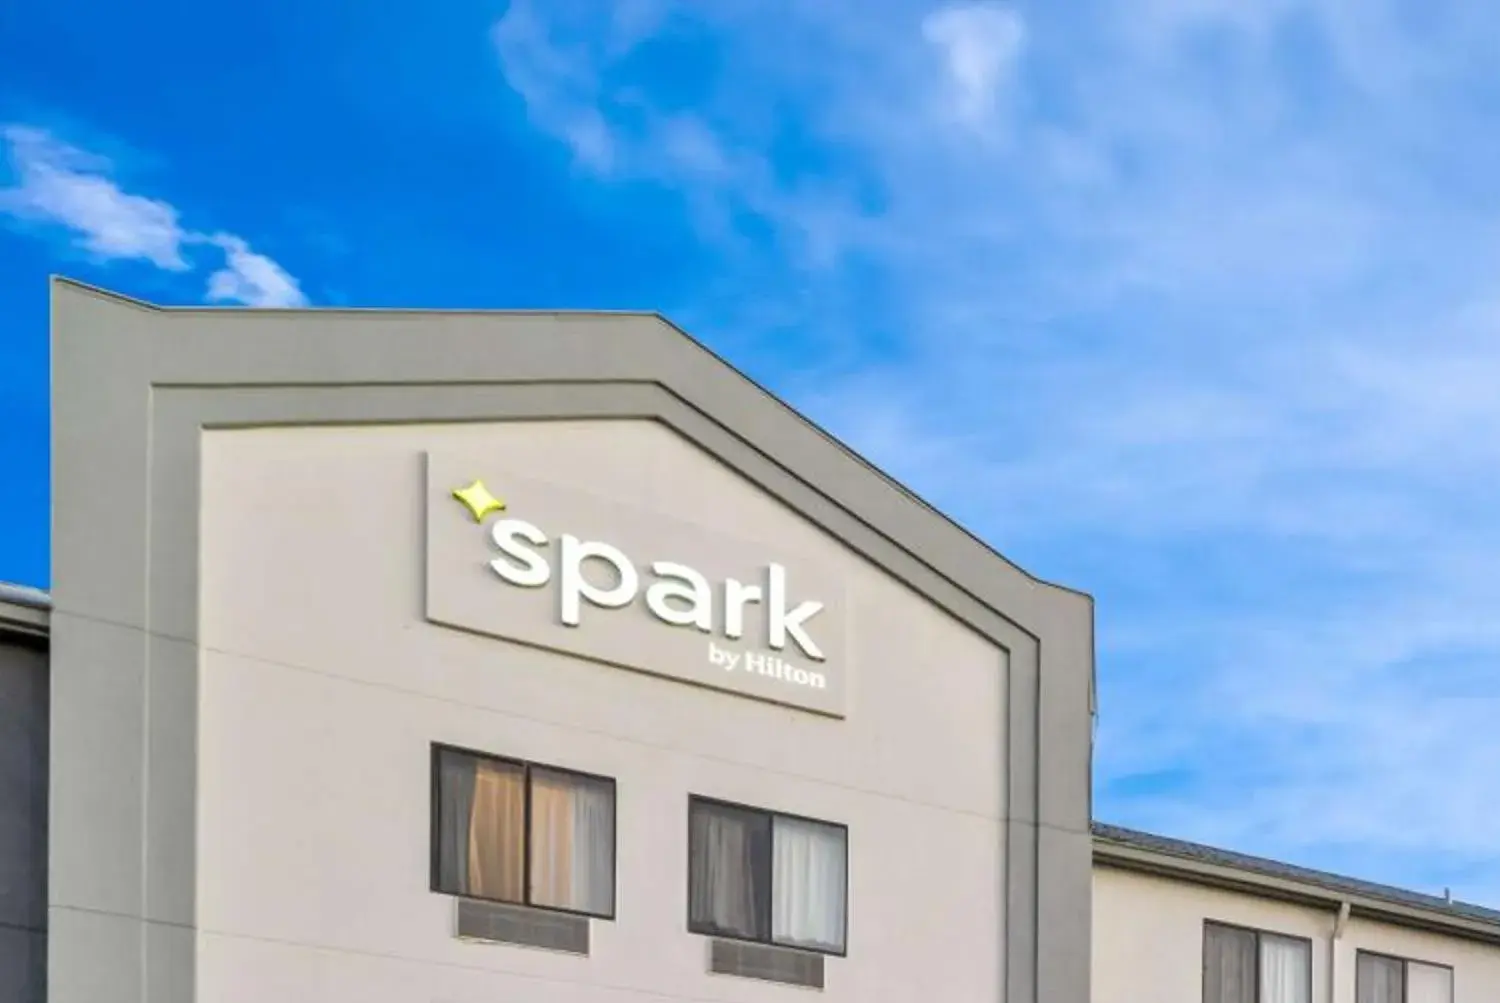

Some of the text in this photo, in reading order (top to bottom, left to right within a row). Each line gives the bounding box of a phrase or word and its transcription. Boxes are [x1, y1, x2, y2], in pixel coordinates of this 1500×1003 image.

[489, 519, 826, 661] spark
[709, 642, 826, 690] by Hilton
